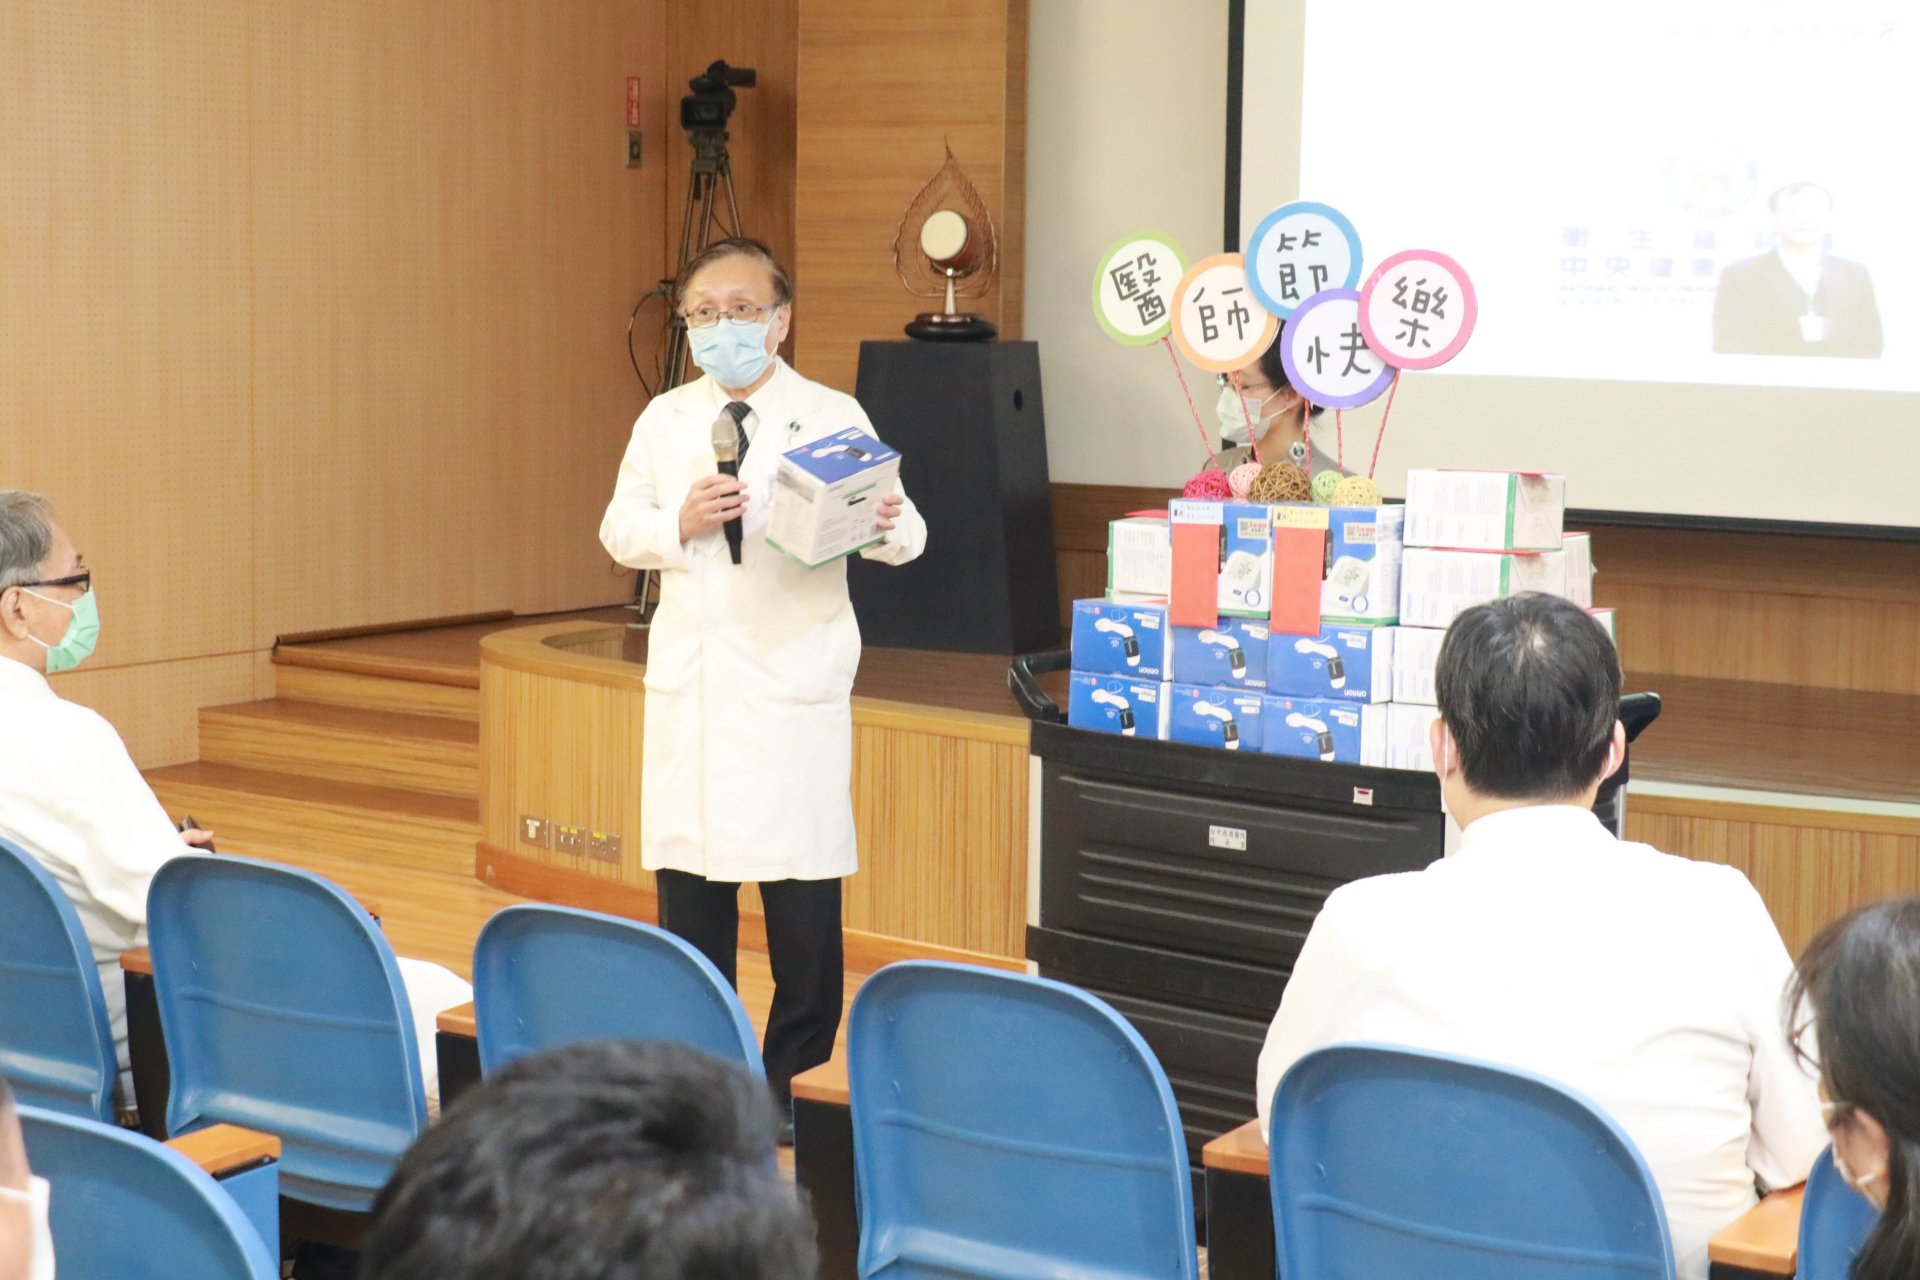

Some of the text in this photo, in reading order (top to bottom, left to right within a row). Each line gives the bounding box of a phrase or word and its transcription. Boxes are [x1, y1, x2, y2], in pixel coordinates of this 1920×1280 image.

[1109, 252, 1167, 326] 醫
[1276, 228, 1329, 301] 節
[1192, 286, 1251, 343] 師
[1391, 275, 1448, 349] 樂
[1306, 322, 1373, 377] 快
